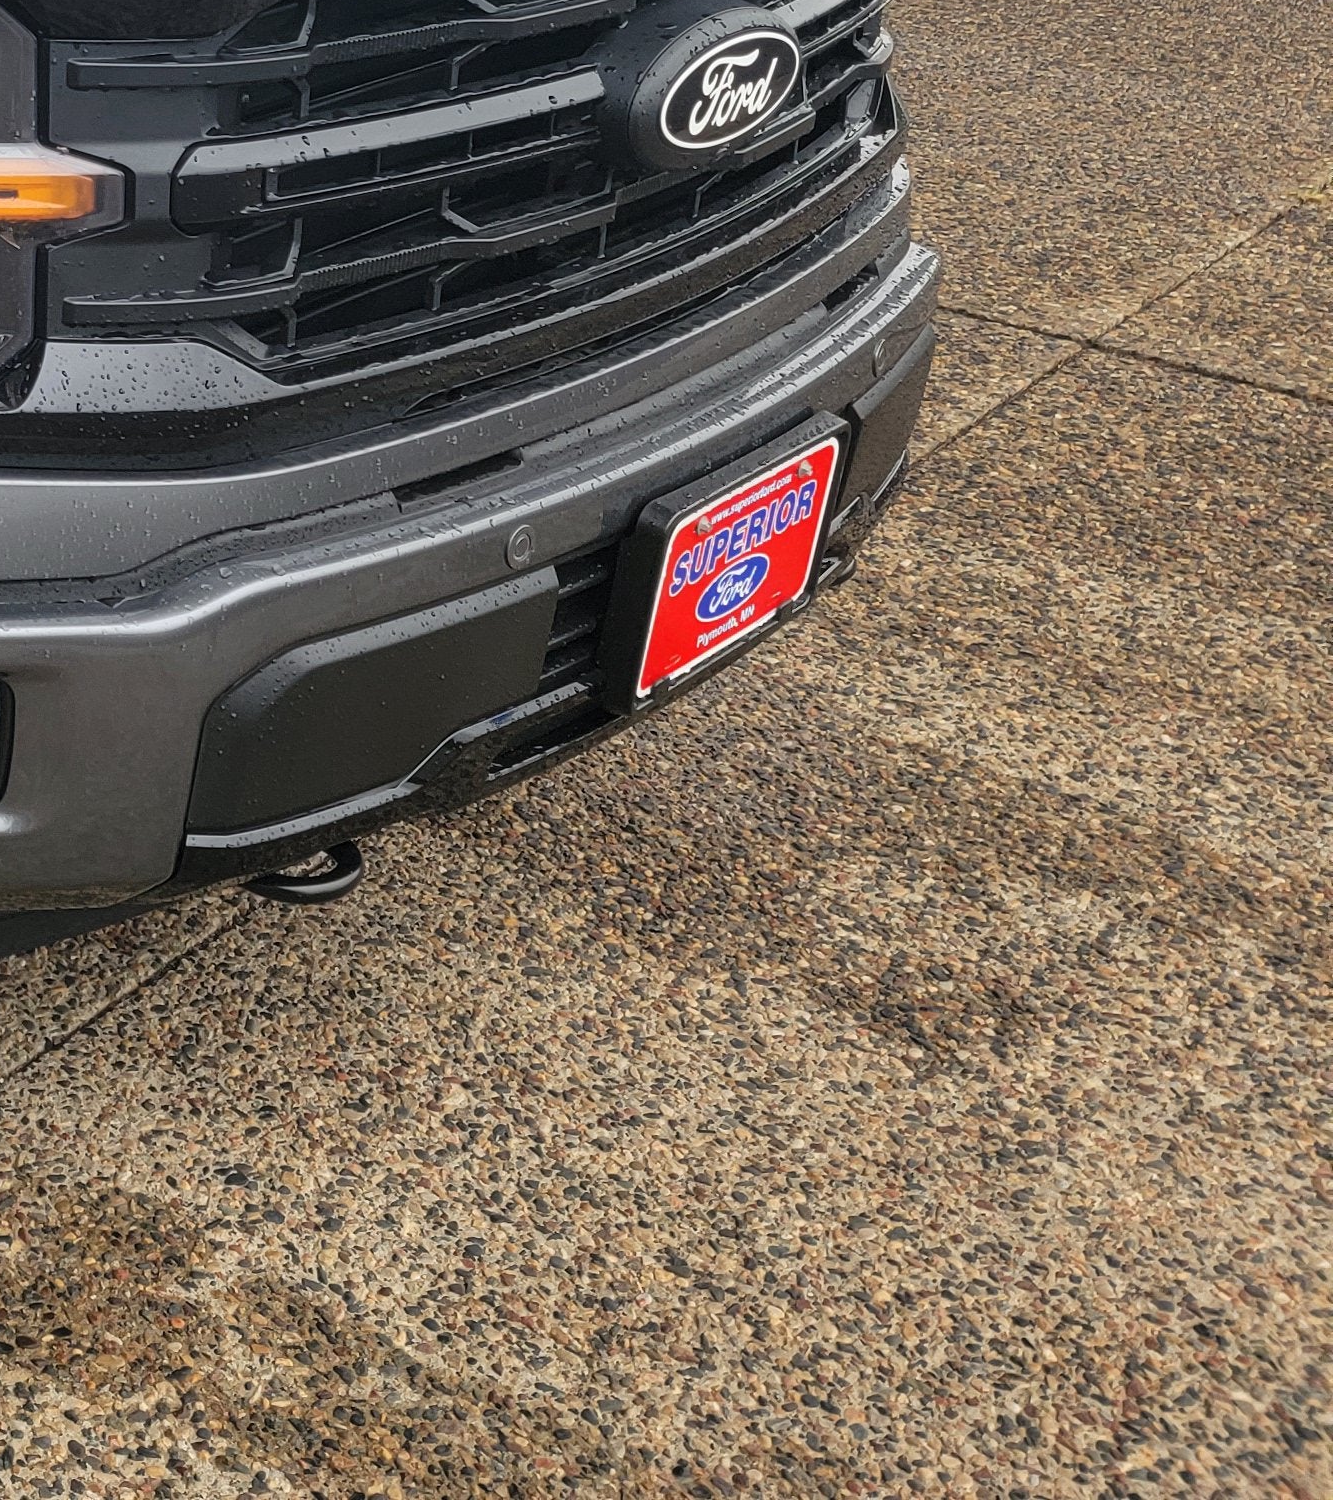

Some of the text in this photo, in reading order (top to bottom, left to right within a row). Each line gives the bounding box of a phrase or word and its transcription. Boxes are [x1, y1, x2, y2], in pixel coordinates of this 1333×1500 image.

[688, 48, 779, 136] Ford
[668, 479, 818, 597] SUPERIOR
[708, 564, 758, 614] Ford
[696, 615, 739, 649] Plymouth,
